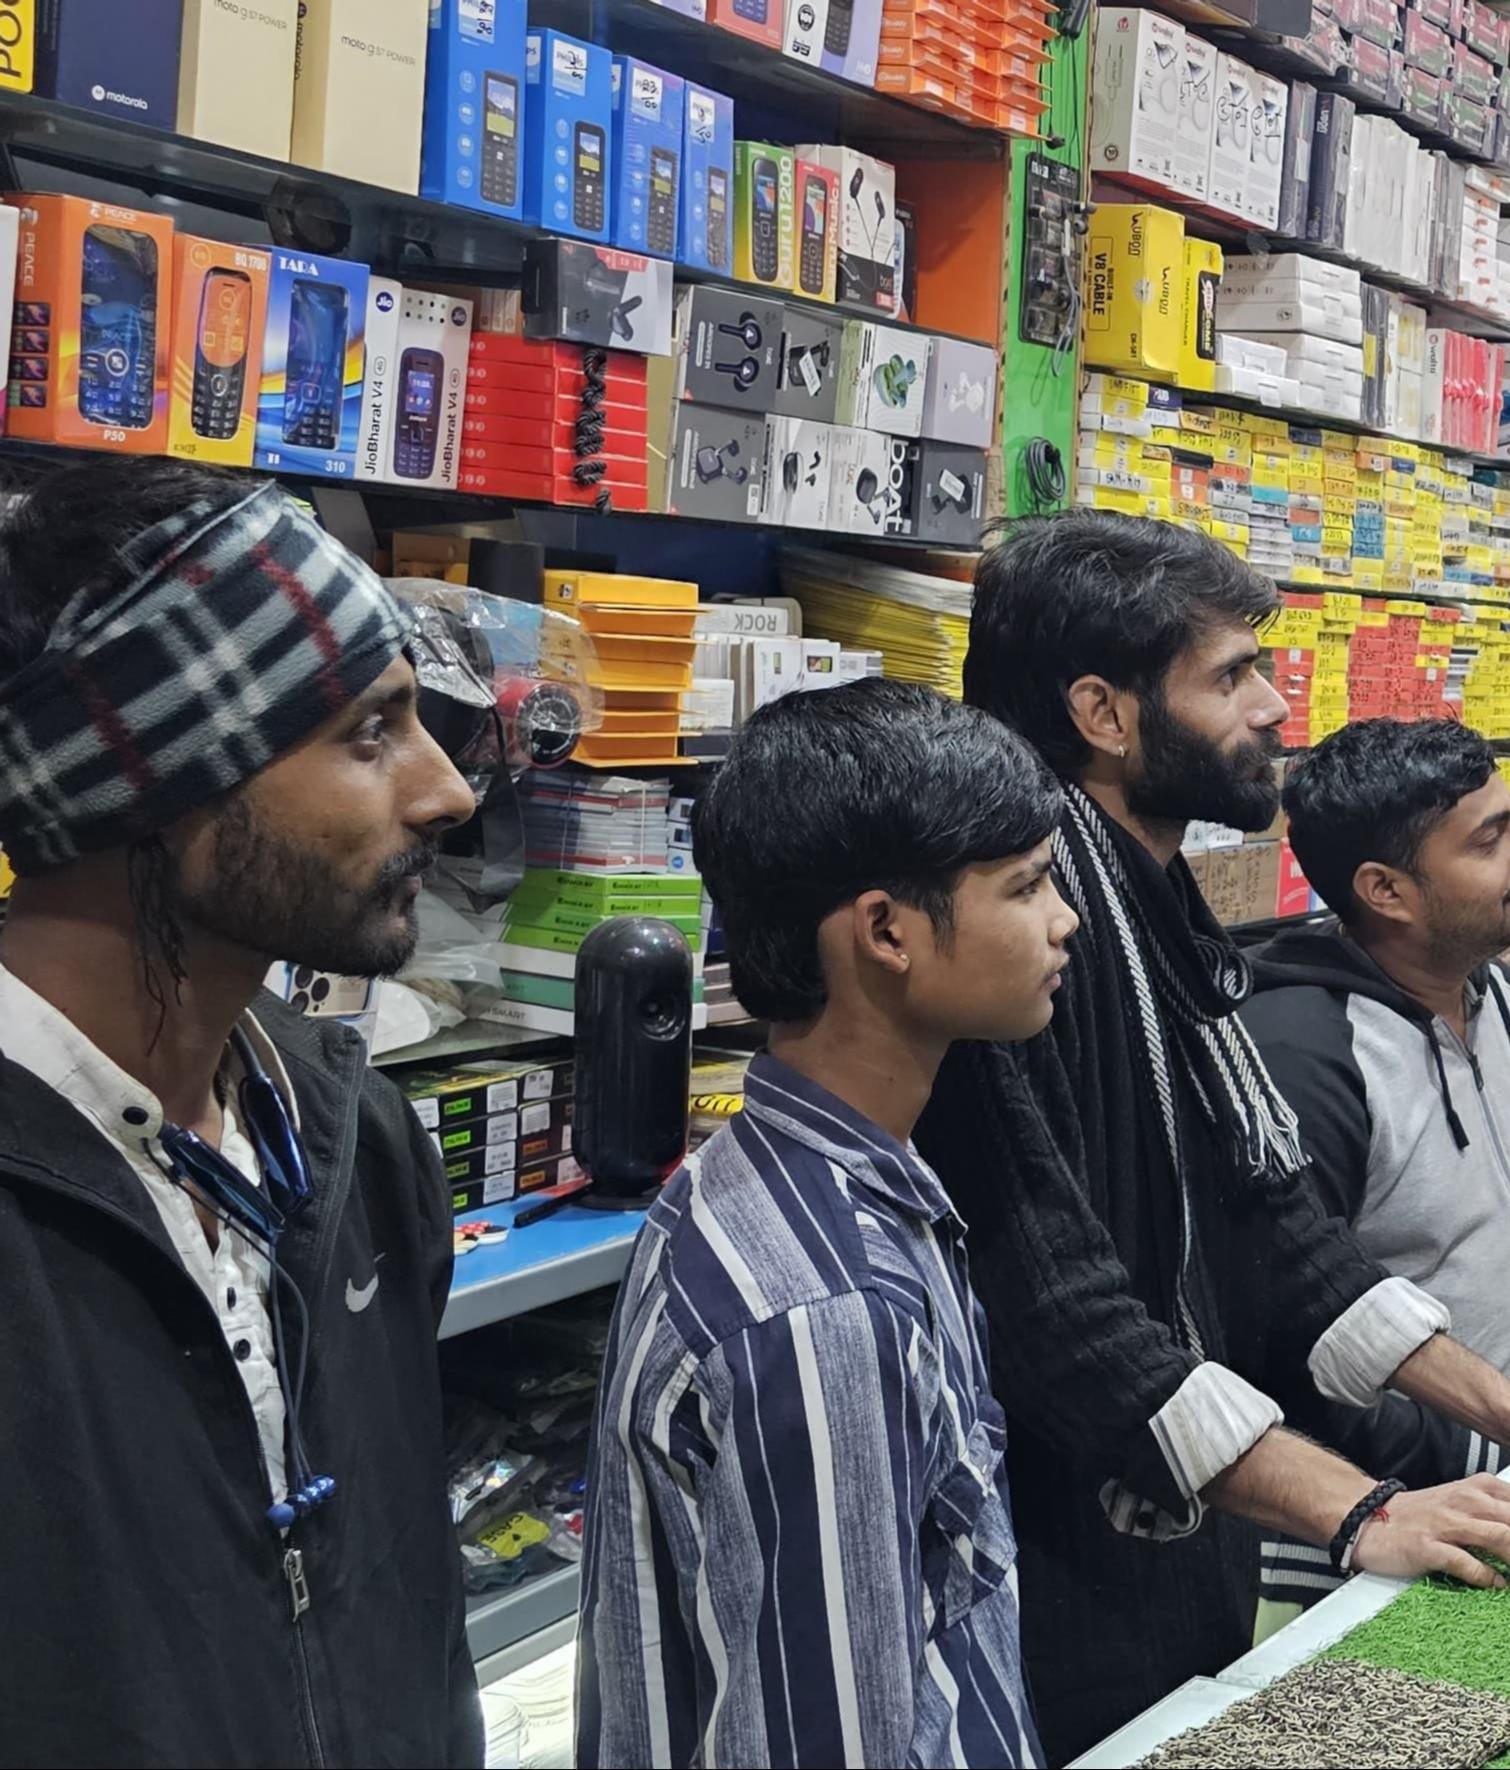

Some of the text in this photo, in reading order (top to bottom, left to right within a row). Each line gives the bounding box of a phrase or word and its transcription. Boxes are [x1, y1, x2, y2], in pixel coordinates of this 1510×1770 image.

[106, 90, 148, 111] motorola
[279, 256, 319, 276] TARA
[1092, 252, 1107, 316] V8 CABLE
[103, 430, 126, 442] P50
[364, 380, 384, 475] JioBharat V4
[441, 391, 458, 483] JioBharat V4
[325, 459, 346, 473] 310
[735, 613, 777, 632] ROCK
